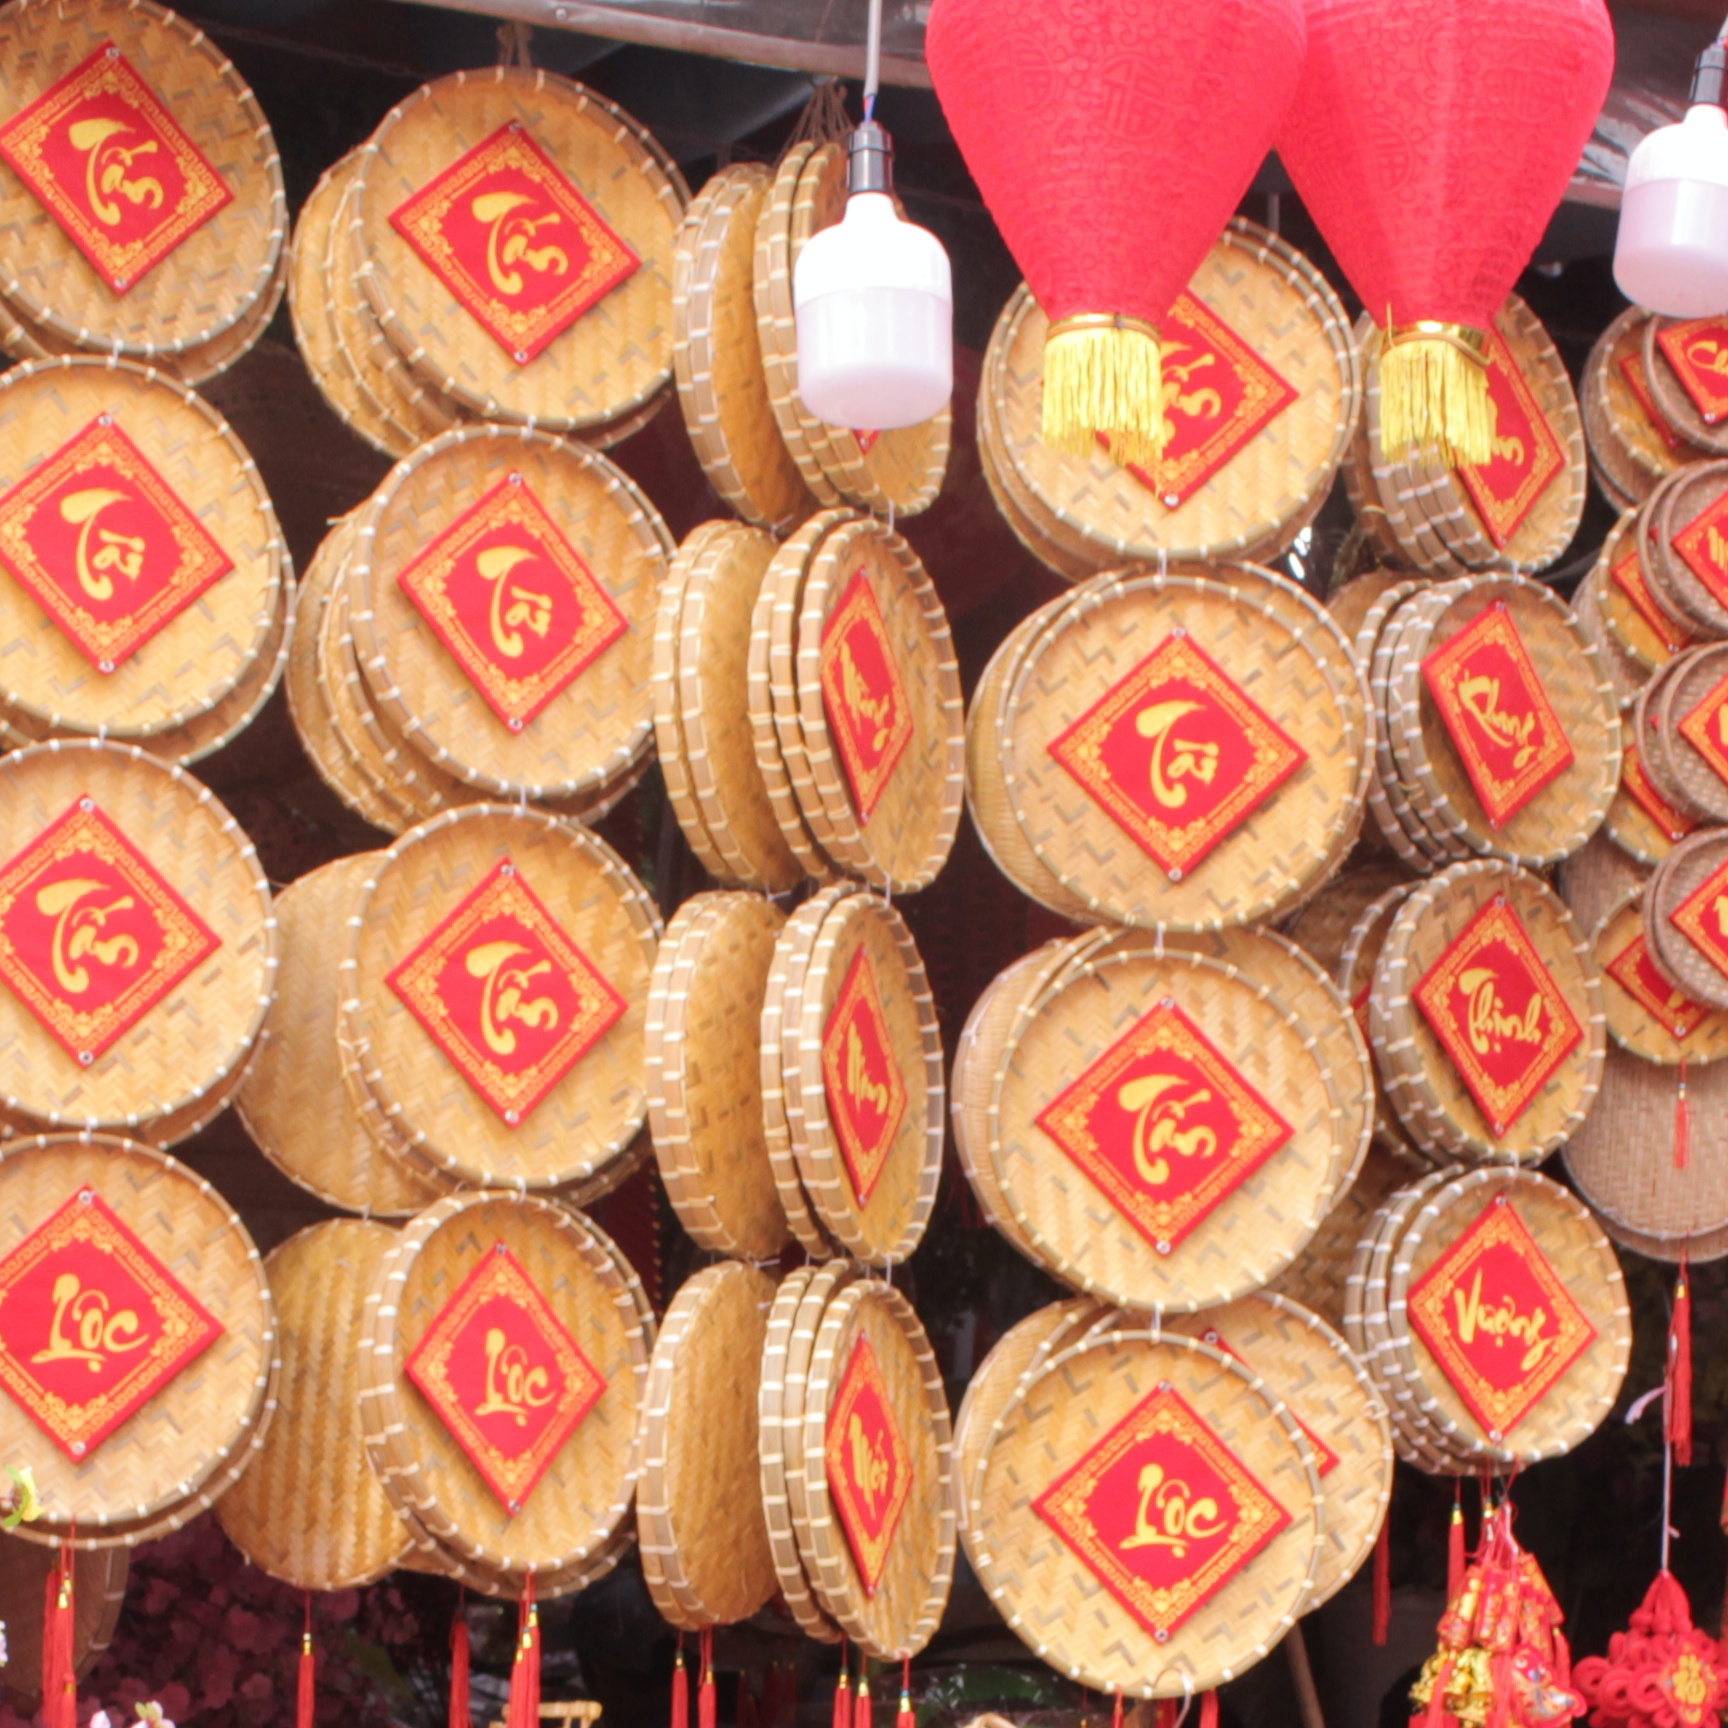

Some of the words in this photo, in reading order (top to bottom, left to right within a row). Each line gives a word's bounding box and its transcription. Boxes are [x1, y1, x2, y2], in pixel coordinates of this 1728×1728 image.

[65, 110, 169, 228] Tấn
[467, 186, 573, 297] Tấn
[30, 873, 144, 996] Tấn
[460, 935, 566, 1058] Tấn
[1455, 970, 1542, 1060] Thịnh
[1114, 1070, 1221, 1188] Tấn
[26, 1268, 152, 1374] Lộc
[1448, 1261, 1549, 1374] Vượng
[470, 1324, 563, 1427] Lộc
[1113, 1459, 1231, 1561] Lộc
